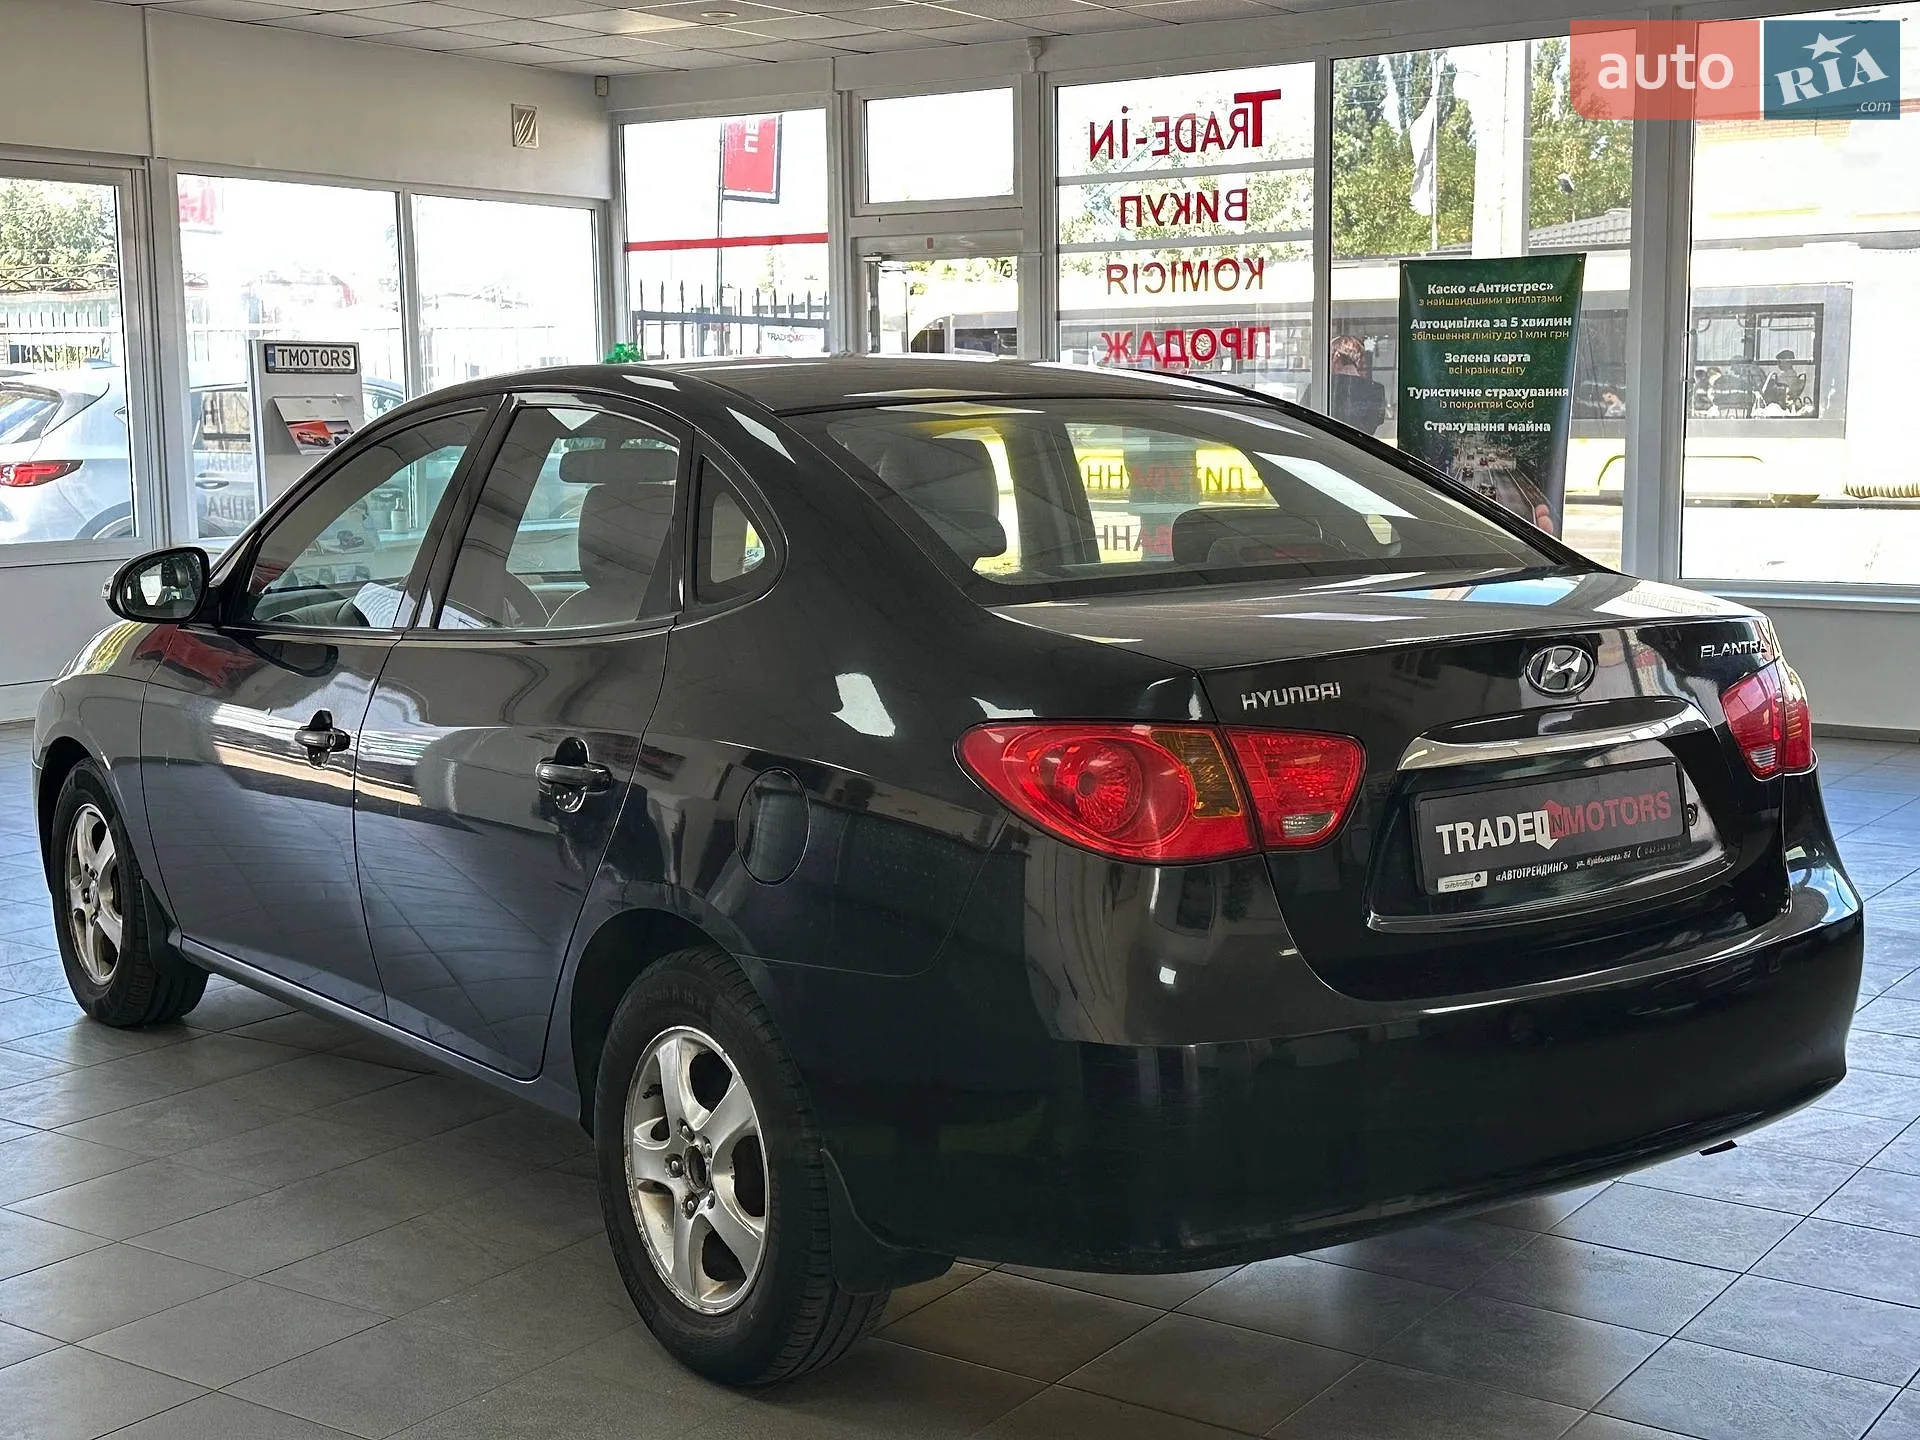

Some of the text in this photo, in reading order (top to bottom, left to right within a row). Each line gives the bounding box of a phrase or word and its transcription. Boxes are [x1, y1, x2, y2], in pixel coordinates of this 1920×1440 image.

[1428, 281, 1554, 295] Каско «Антистрес»
[1426, 296, 1503, 306] найшвидшими
[1505, 294, 1562, 304] виплатами
[1410, 316, 1572, 331] Автоцивілка за 5 хвилин
[1412, 331, 1470, 341] збільшення
[1472, 330, 1502, 341] ліміту
[1504, 330, 1517, 340] до
[1519, 330, 1524, 339] 1
[1550, 330, 1569, 340] грн
[277, 348, 351, 367] TMOTORS
[1444, 352, 1531, 365] Зелена карта
[1449, 366, 1463, 375] всі
[1407, 386, 1569, 399] Туристичне страхування
[1449, 399, 1503, 410] покриттям
[1505, 399, 1534, 409] Covid
[1424, 420, 1551, 433] Страхування майна
[1700, 640, 1768, 658] ELANTRA
[1240, 681, 1341, 711] HYUNDAI
